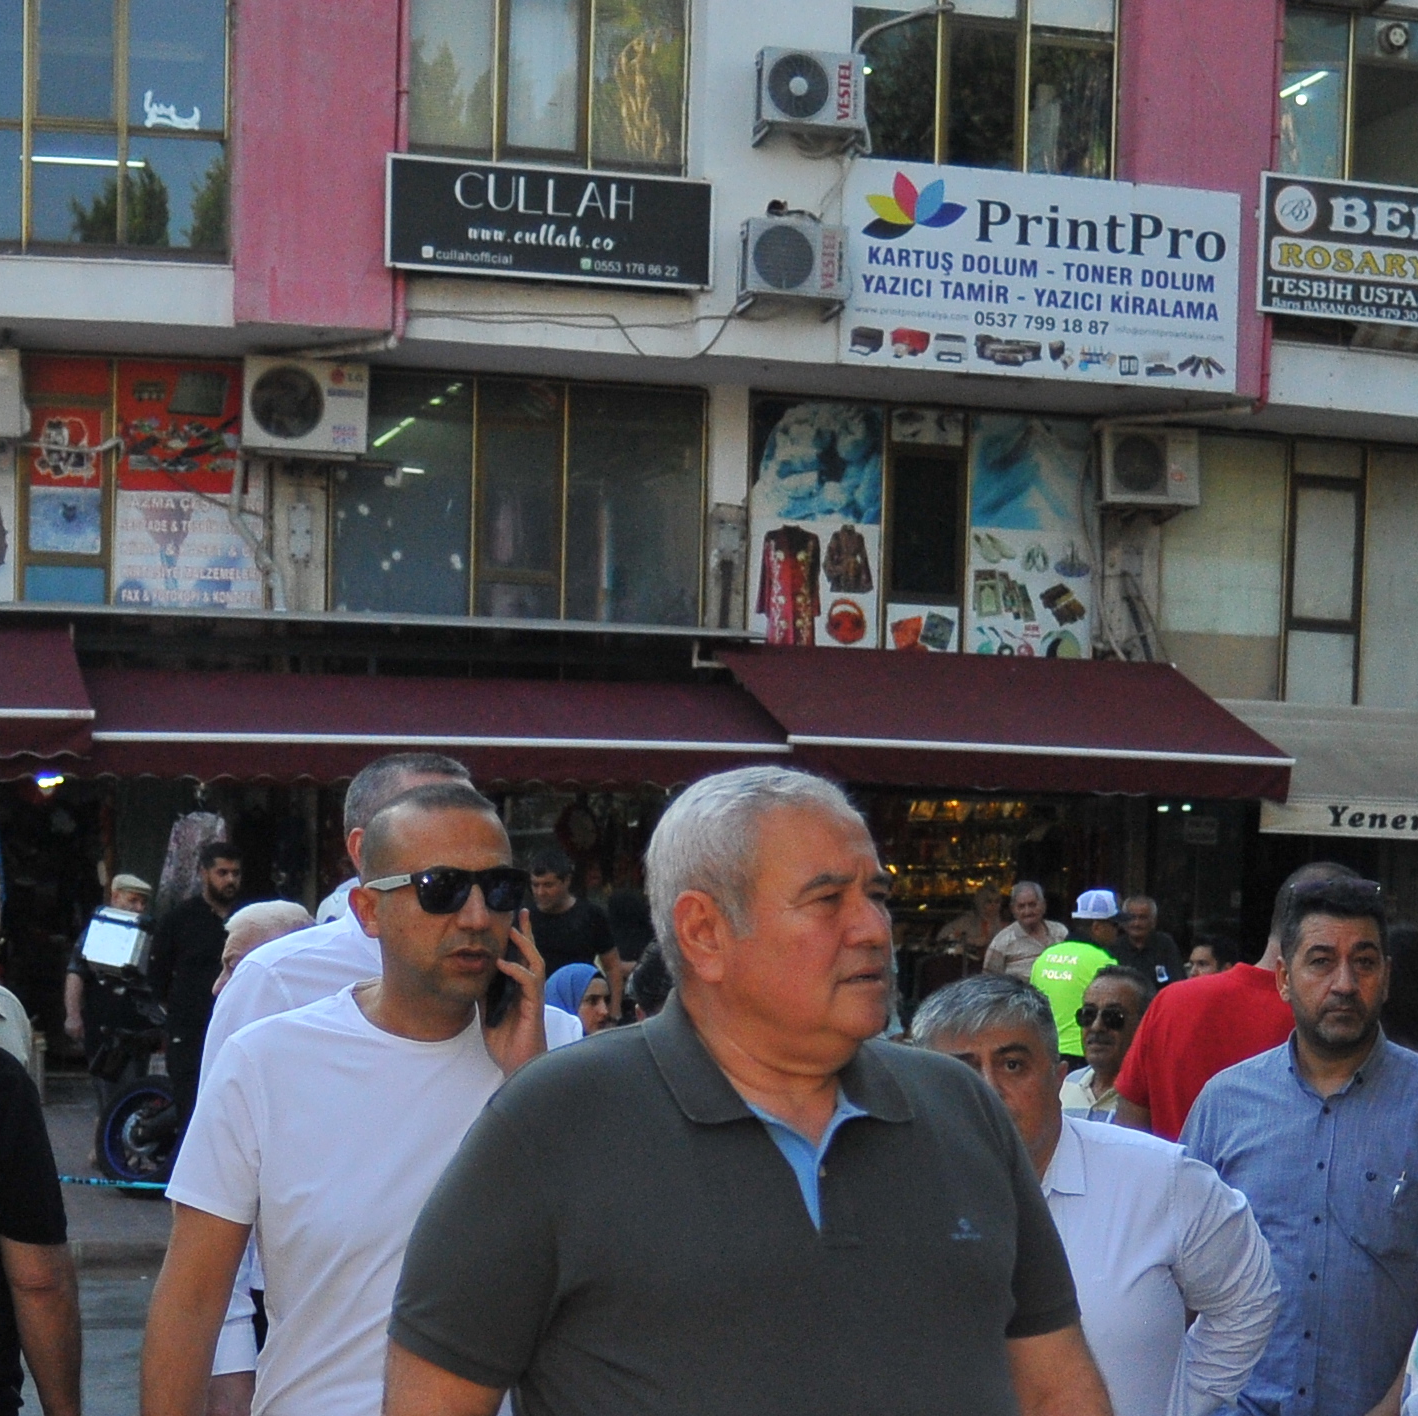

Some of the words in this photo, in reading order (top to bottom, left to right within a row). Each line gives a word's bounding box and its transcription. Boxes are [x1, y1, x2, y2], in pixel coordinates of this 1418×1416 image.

[836, 61, 853, 121] VESTEL
[454, 171, 634, 221] CULLAH
[975, 199, 1226, 263] PrintPro
[820, 232, 837, 290] VESTEL
[868, 246, 953, 275] KARTUŞ
[962, 254, 1038, 279] DOLUM
[1063, 262, 1132, 286] TONER
[1141, 268, 1215, 293] DOLUM
[862, 274, 931, 298] YAZICI
[940, 278, 1009, 304] TAMİR
[1033, 287, 1102, 312] YAZICI
[1110, 290, 1219, 322] KİRALAMA
[1267, 277, 1353, 302] TESBİH
[974, 310, 1017, 329] 0537
[1024, 315, 1056, 332] 799
[1063, 318, 1083, 334] 18
[1089, 320, 1110, 336] 87
[121, 588, 140, 602] FAX
